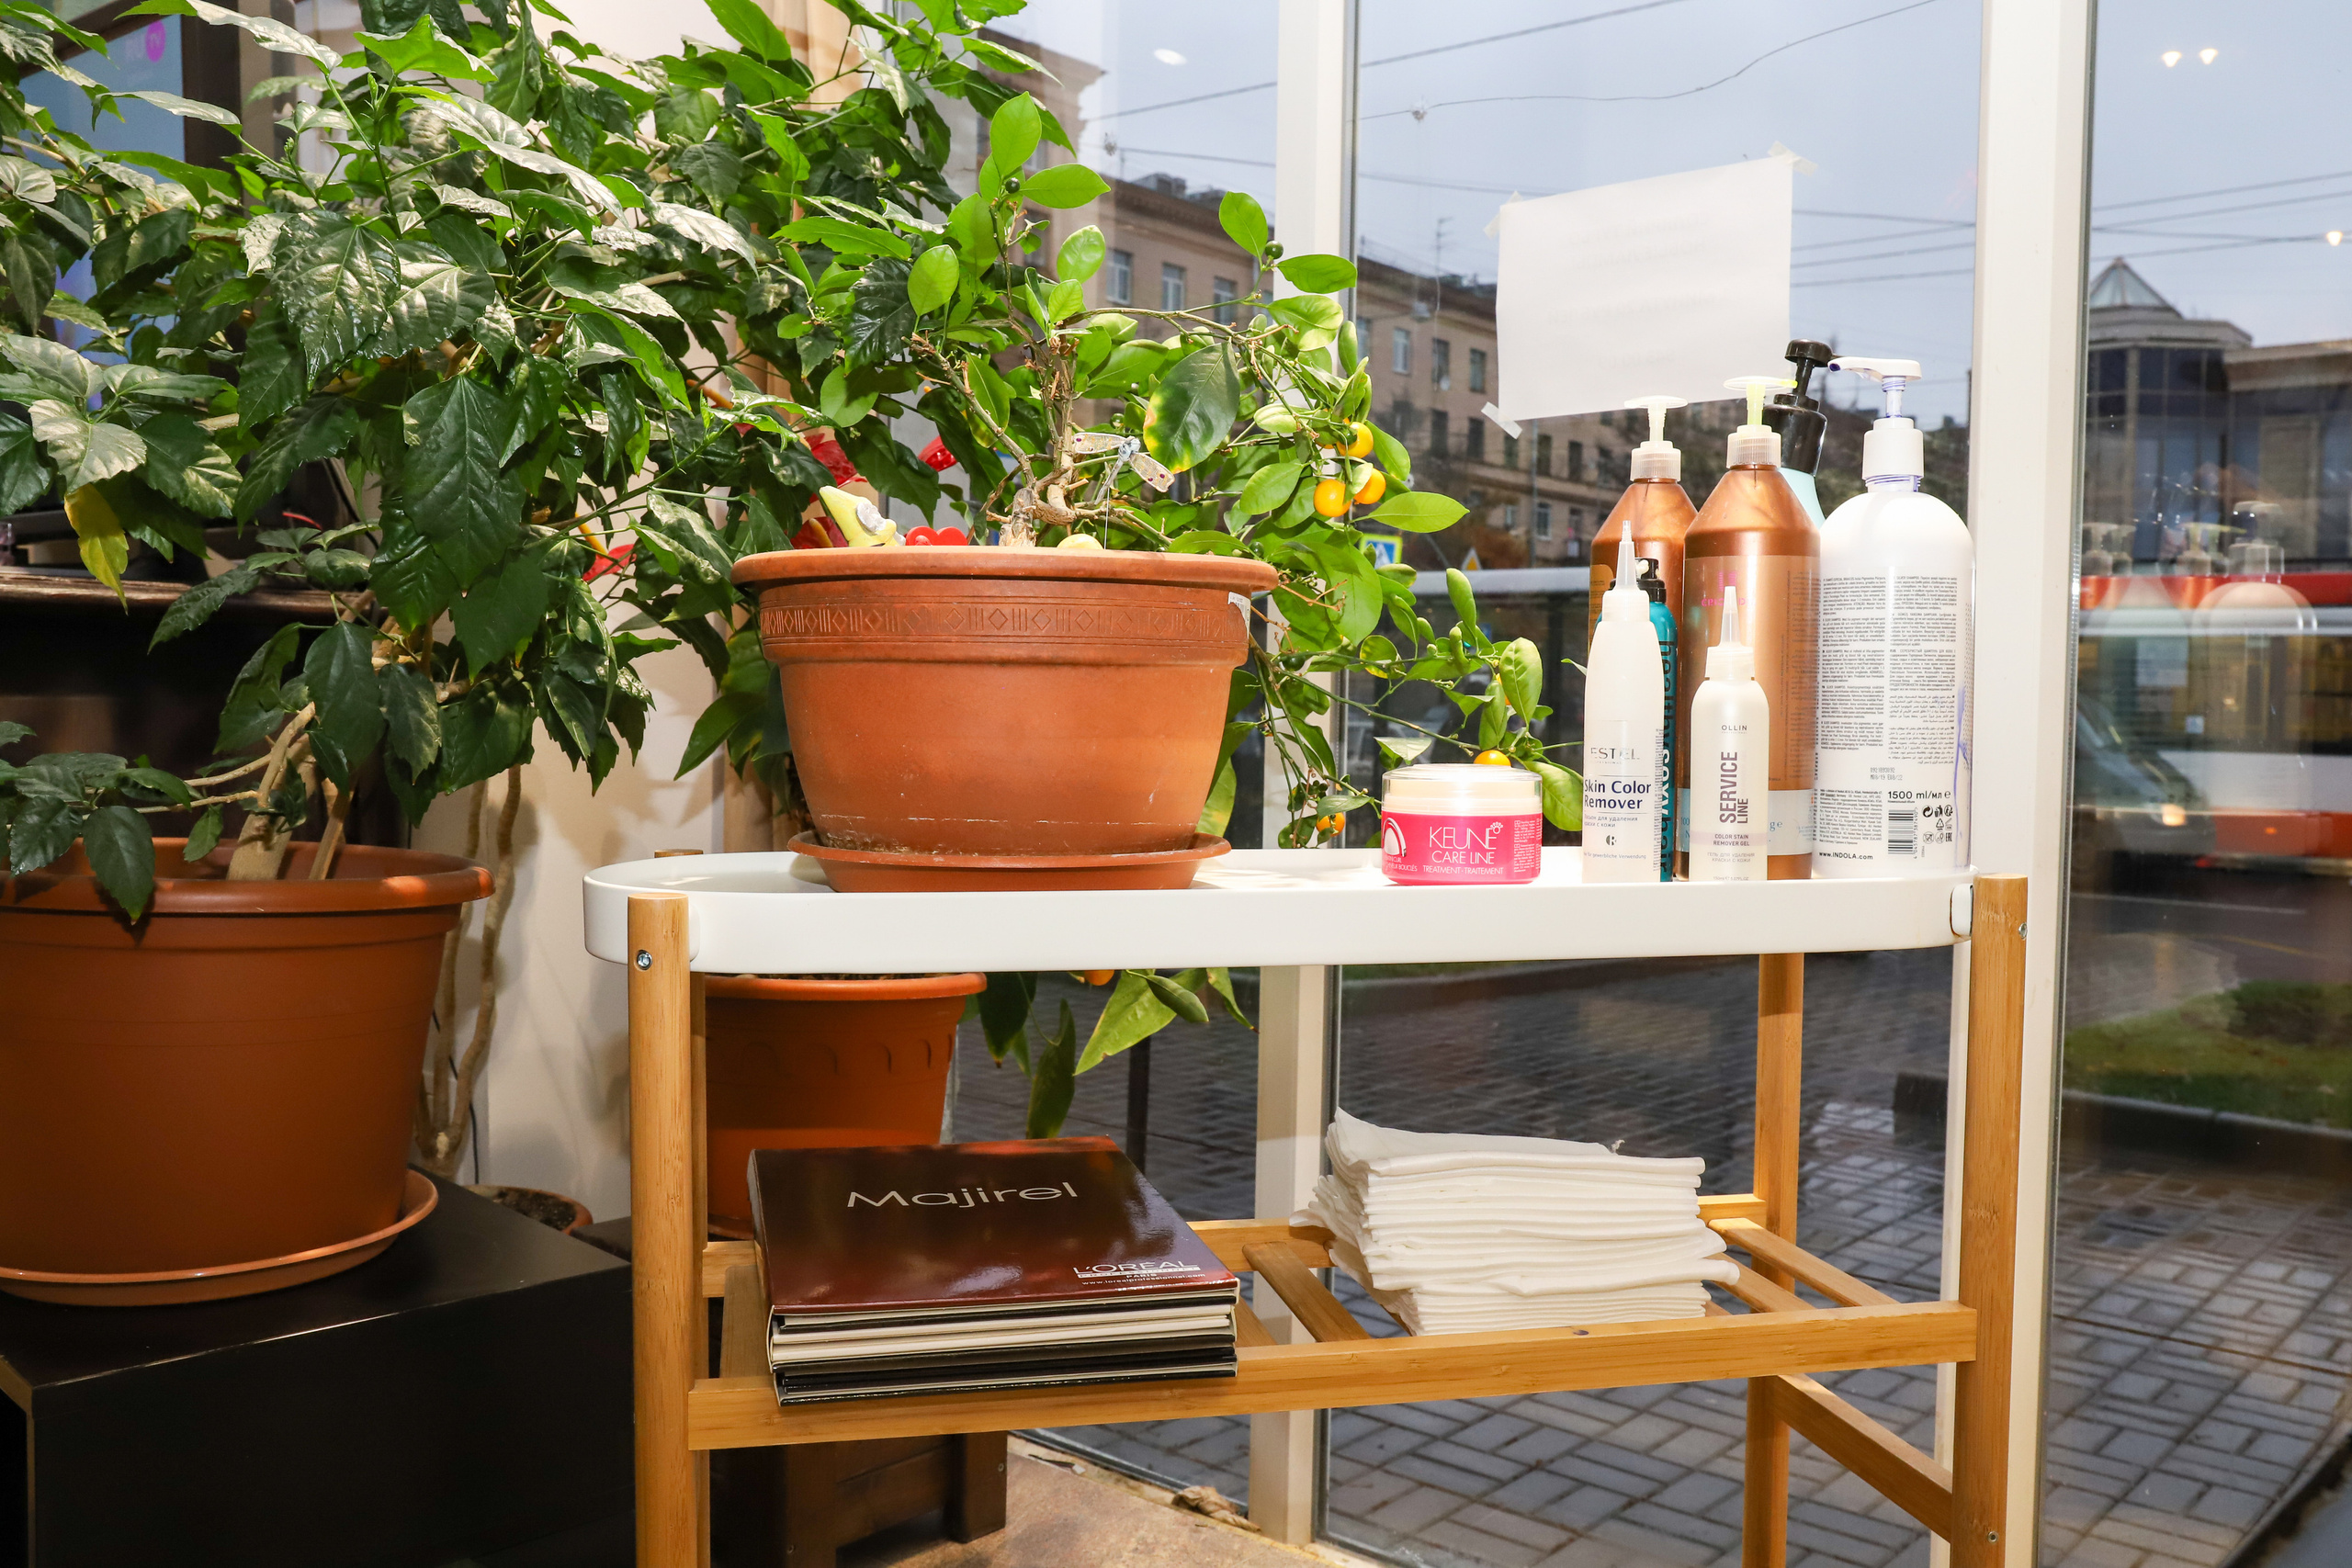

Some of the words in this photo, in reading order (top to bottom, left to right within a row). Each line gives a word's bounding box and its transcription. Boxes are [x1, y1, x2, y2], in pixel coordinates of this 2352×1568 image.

[1584, 779, 1606, 793] Skin
[1611, 780, 1652, 794] Color
[1719, 751, 1737, 824] SERVICE
[1584, 794, 1643, 809] Remover
[1888, 791, 1913, 799] 1500
[1737, 798, 1748, 824] LINE
[1429, 826, 1497, 850] KEUNE
[1431, 851, 1466, 864] CARE
[1470, 852, 1495, 864] LINE
[1818, 852, 1873, 860] www.INDOLA.com
[847, 1181, 1078, 1208] Majirel
